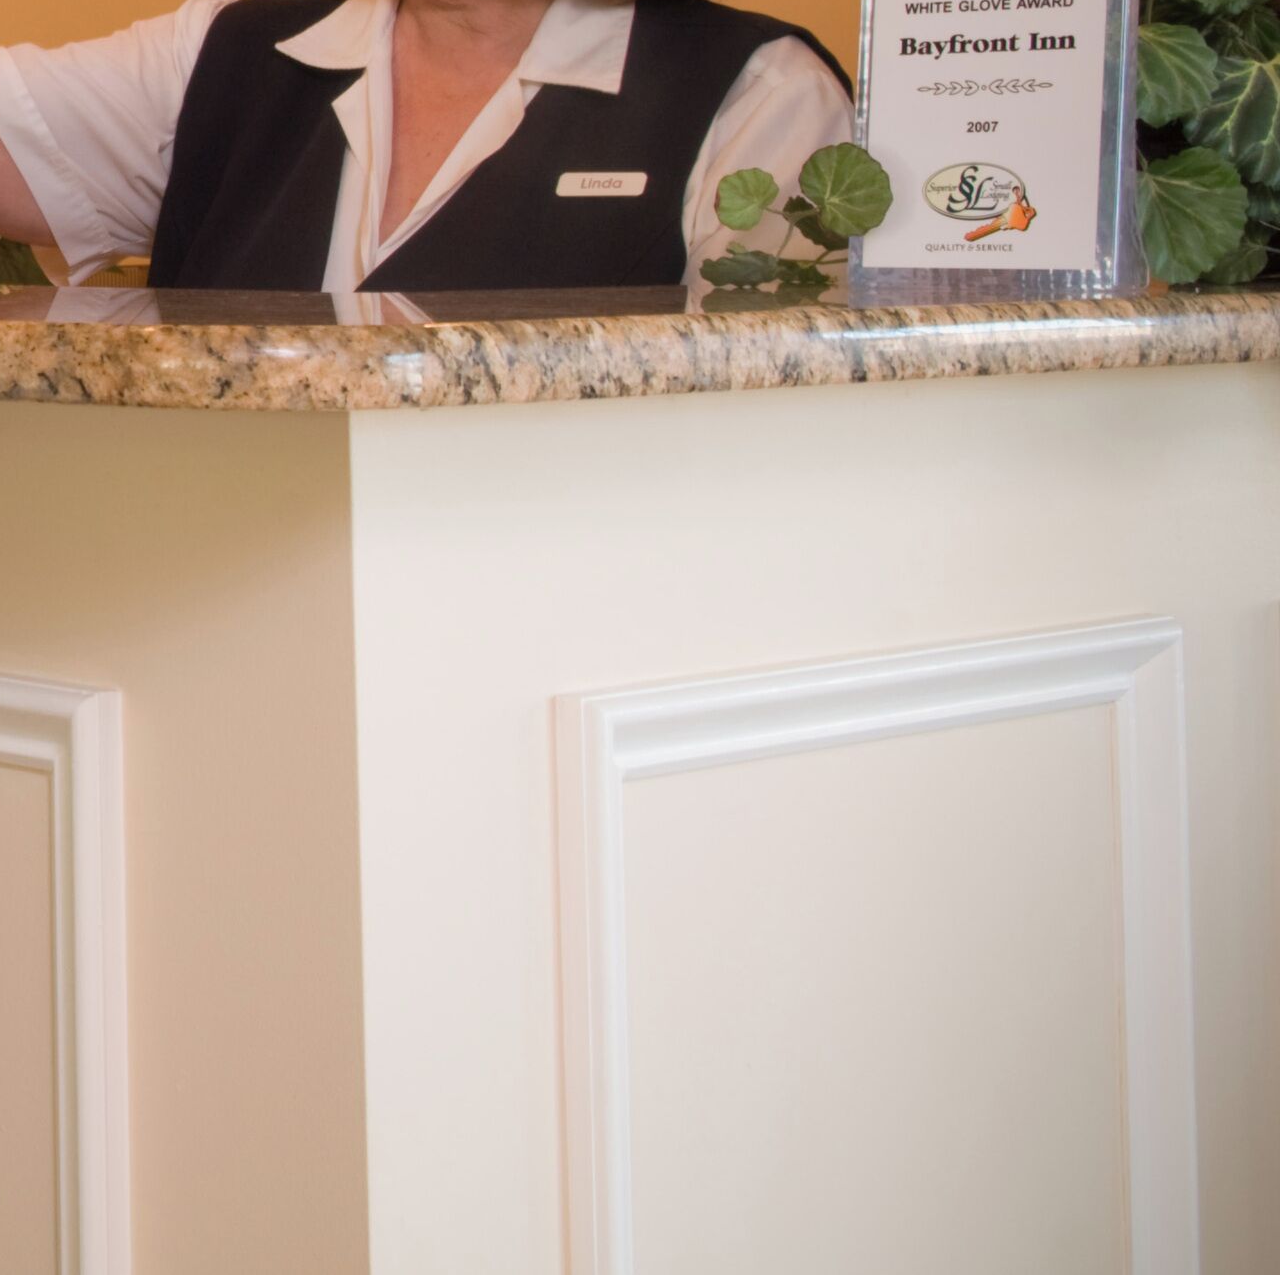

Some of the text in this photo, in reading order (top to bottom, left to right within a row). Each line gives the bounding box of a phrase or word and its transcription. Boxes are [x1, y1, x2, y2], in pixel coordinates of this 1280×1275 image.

[905, 0, 953, 15] WHITE
[899, 31, 1076, 60] Bayfront Inn
[966, 121, 999, 134] 2007
[580, 177, 624, 190] Linda
[925, 243, 965, 253] QUALITY
[976, 243, 1014, 252] SERVICE
